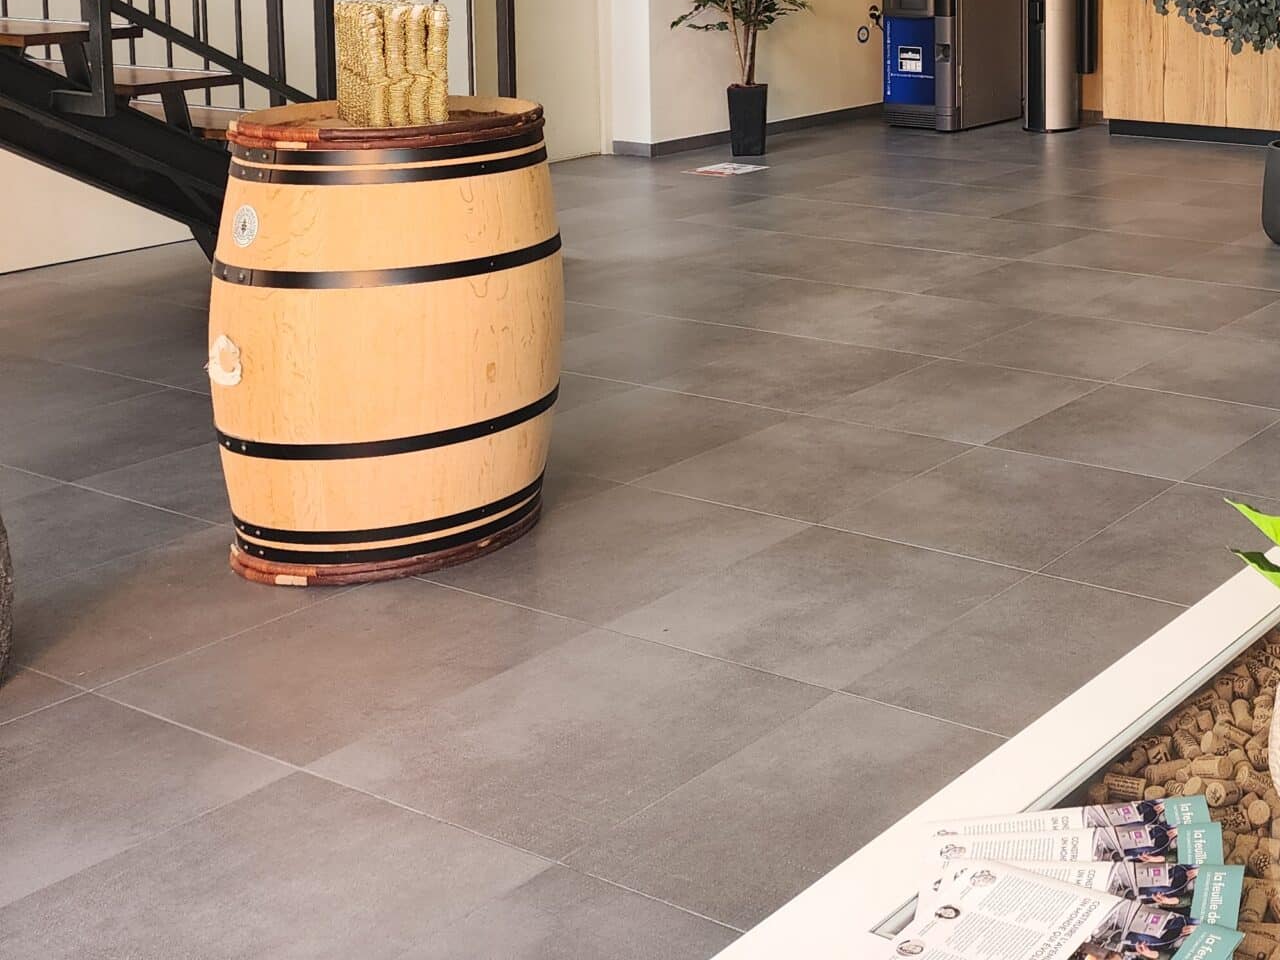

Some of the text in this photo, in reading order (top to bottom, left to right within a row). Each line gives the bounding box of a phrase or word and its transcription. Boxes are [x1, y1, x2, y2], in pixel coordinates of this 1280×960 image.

[1193, 829, 1206, 839] la
[1206, 871, 1227, 925] la feuille de
[1059, 906, 1083, 931] MONDE
[1204, 933, 1222, 946] la
